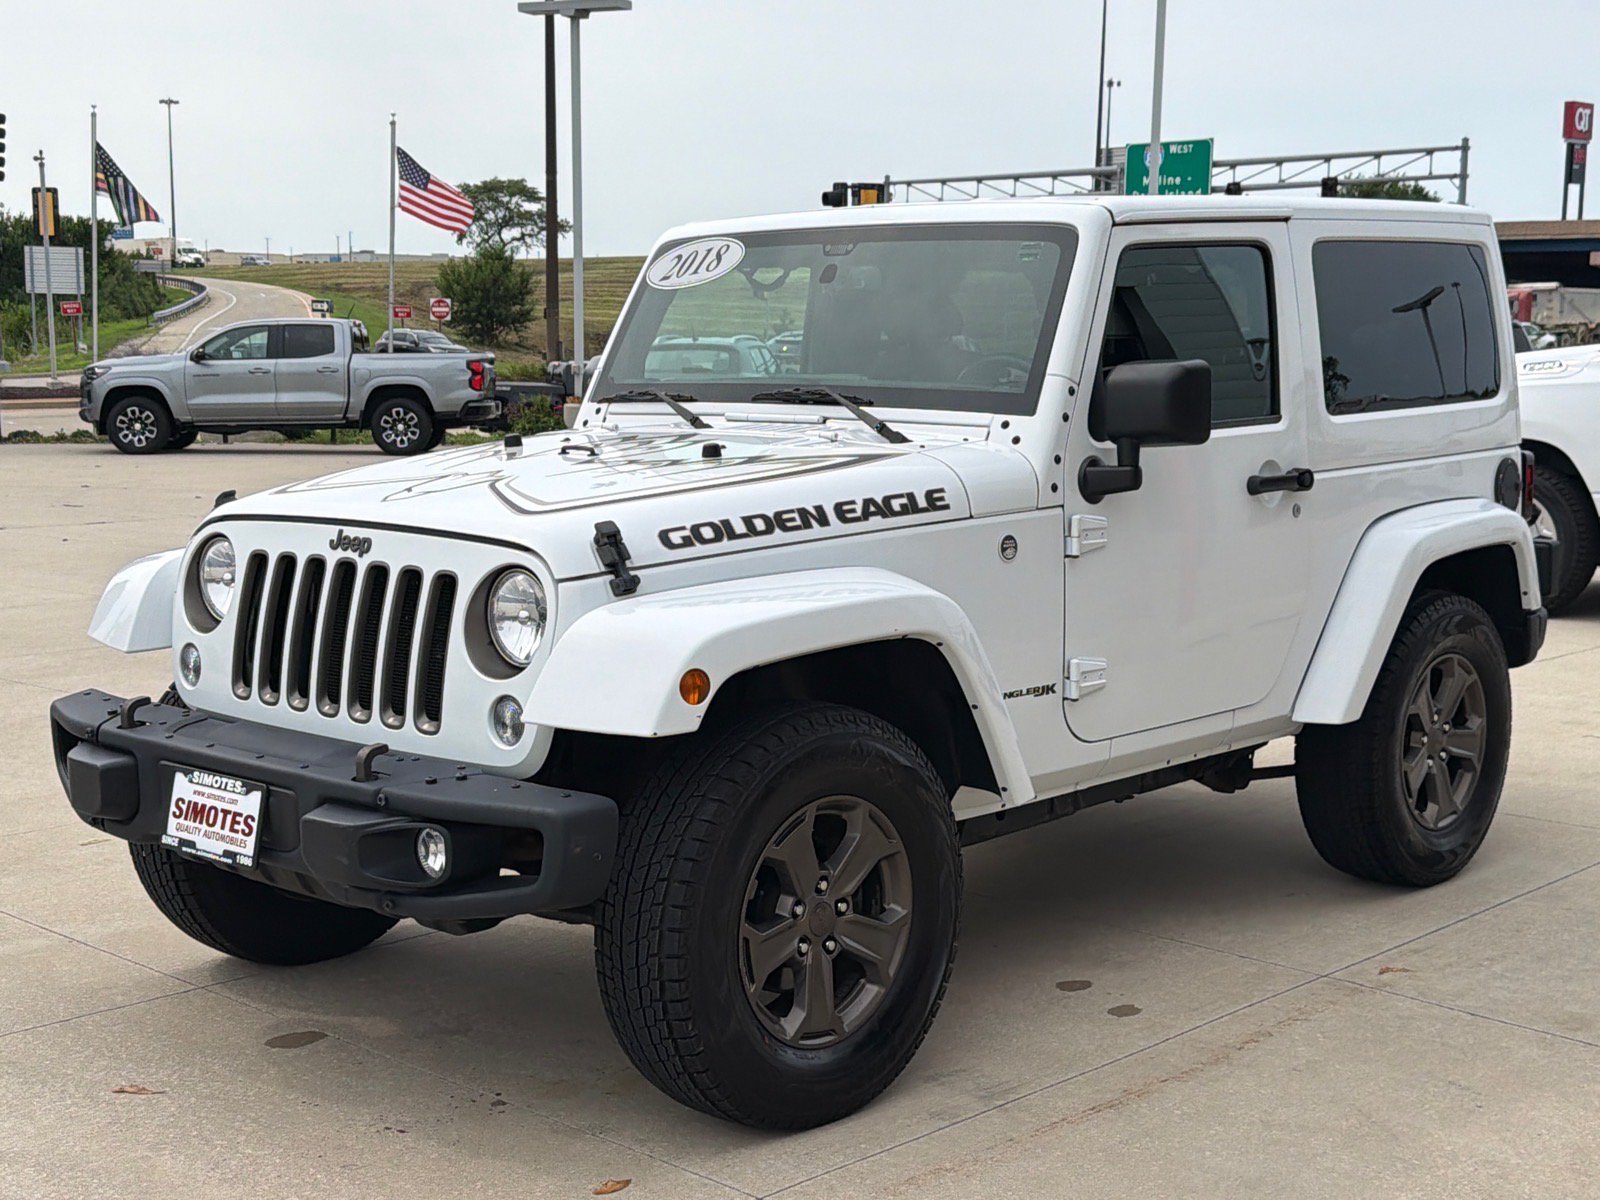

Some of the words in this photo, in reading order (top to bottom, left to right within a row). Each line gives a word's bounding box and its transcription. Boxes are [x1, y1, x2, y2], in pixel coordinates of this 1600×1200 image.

[1574, 106, 1591, 133] QT
[1169, 143, 1194, 154] WEST
[1142, 174, 1182, 187] Mline
[658, 243, 731, 282] 2018
[657, 504, 831, 550] GOLDEN
[833, 487, 951, 524] EAGLE
[329, 529, 372, 558] Jeep
[1003, 686, 1041, 700] NGLER
[191, 771, 243, 794] SIMOTES
[192, 789, 239, 806] www.simotes.com
[172, 797, 256, 837] SIMOTES
[161, 834, 180, 847] SINCE
[175, 822, 202, 837] QUALITY
[202, 829, 248, 849] AUTOMOBILES
